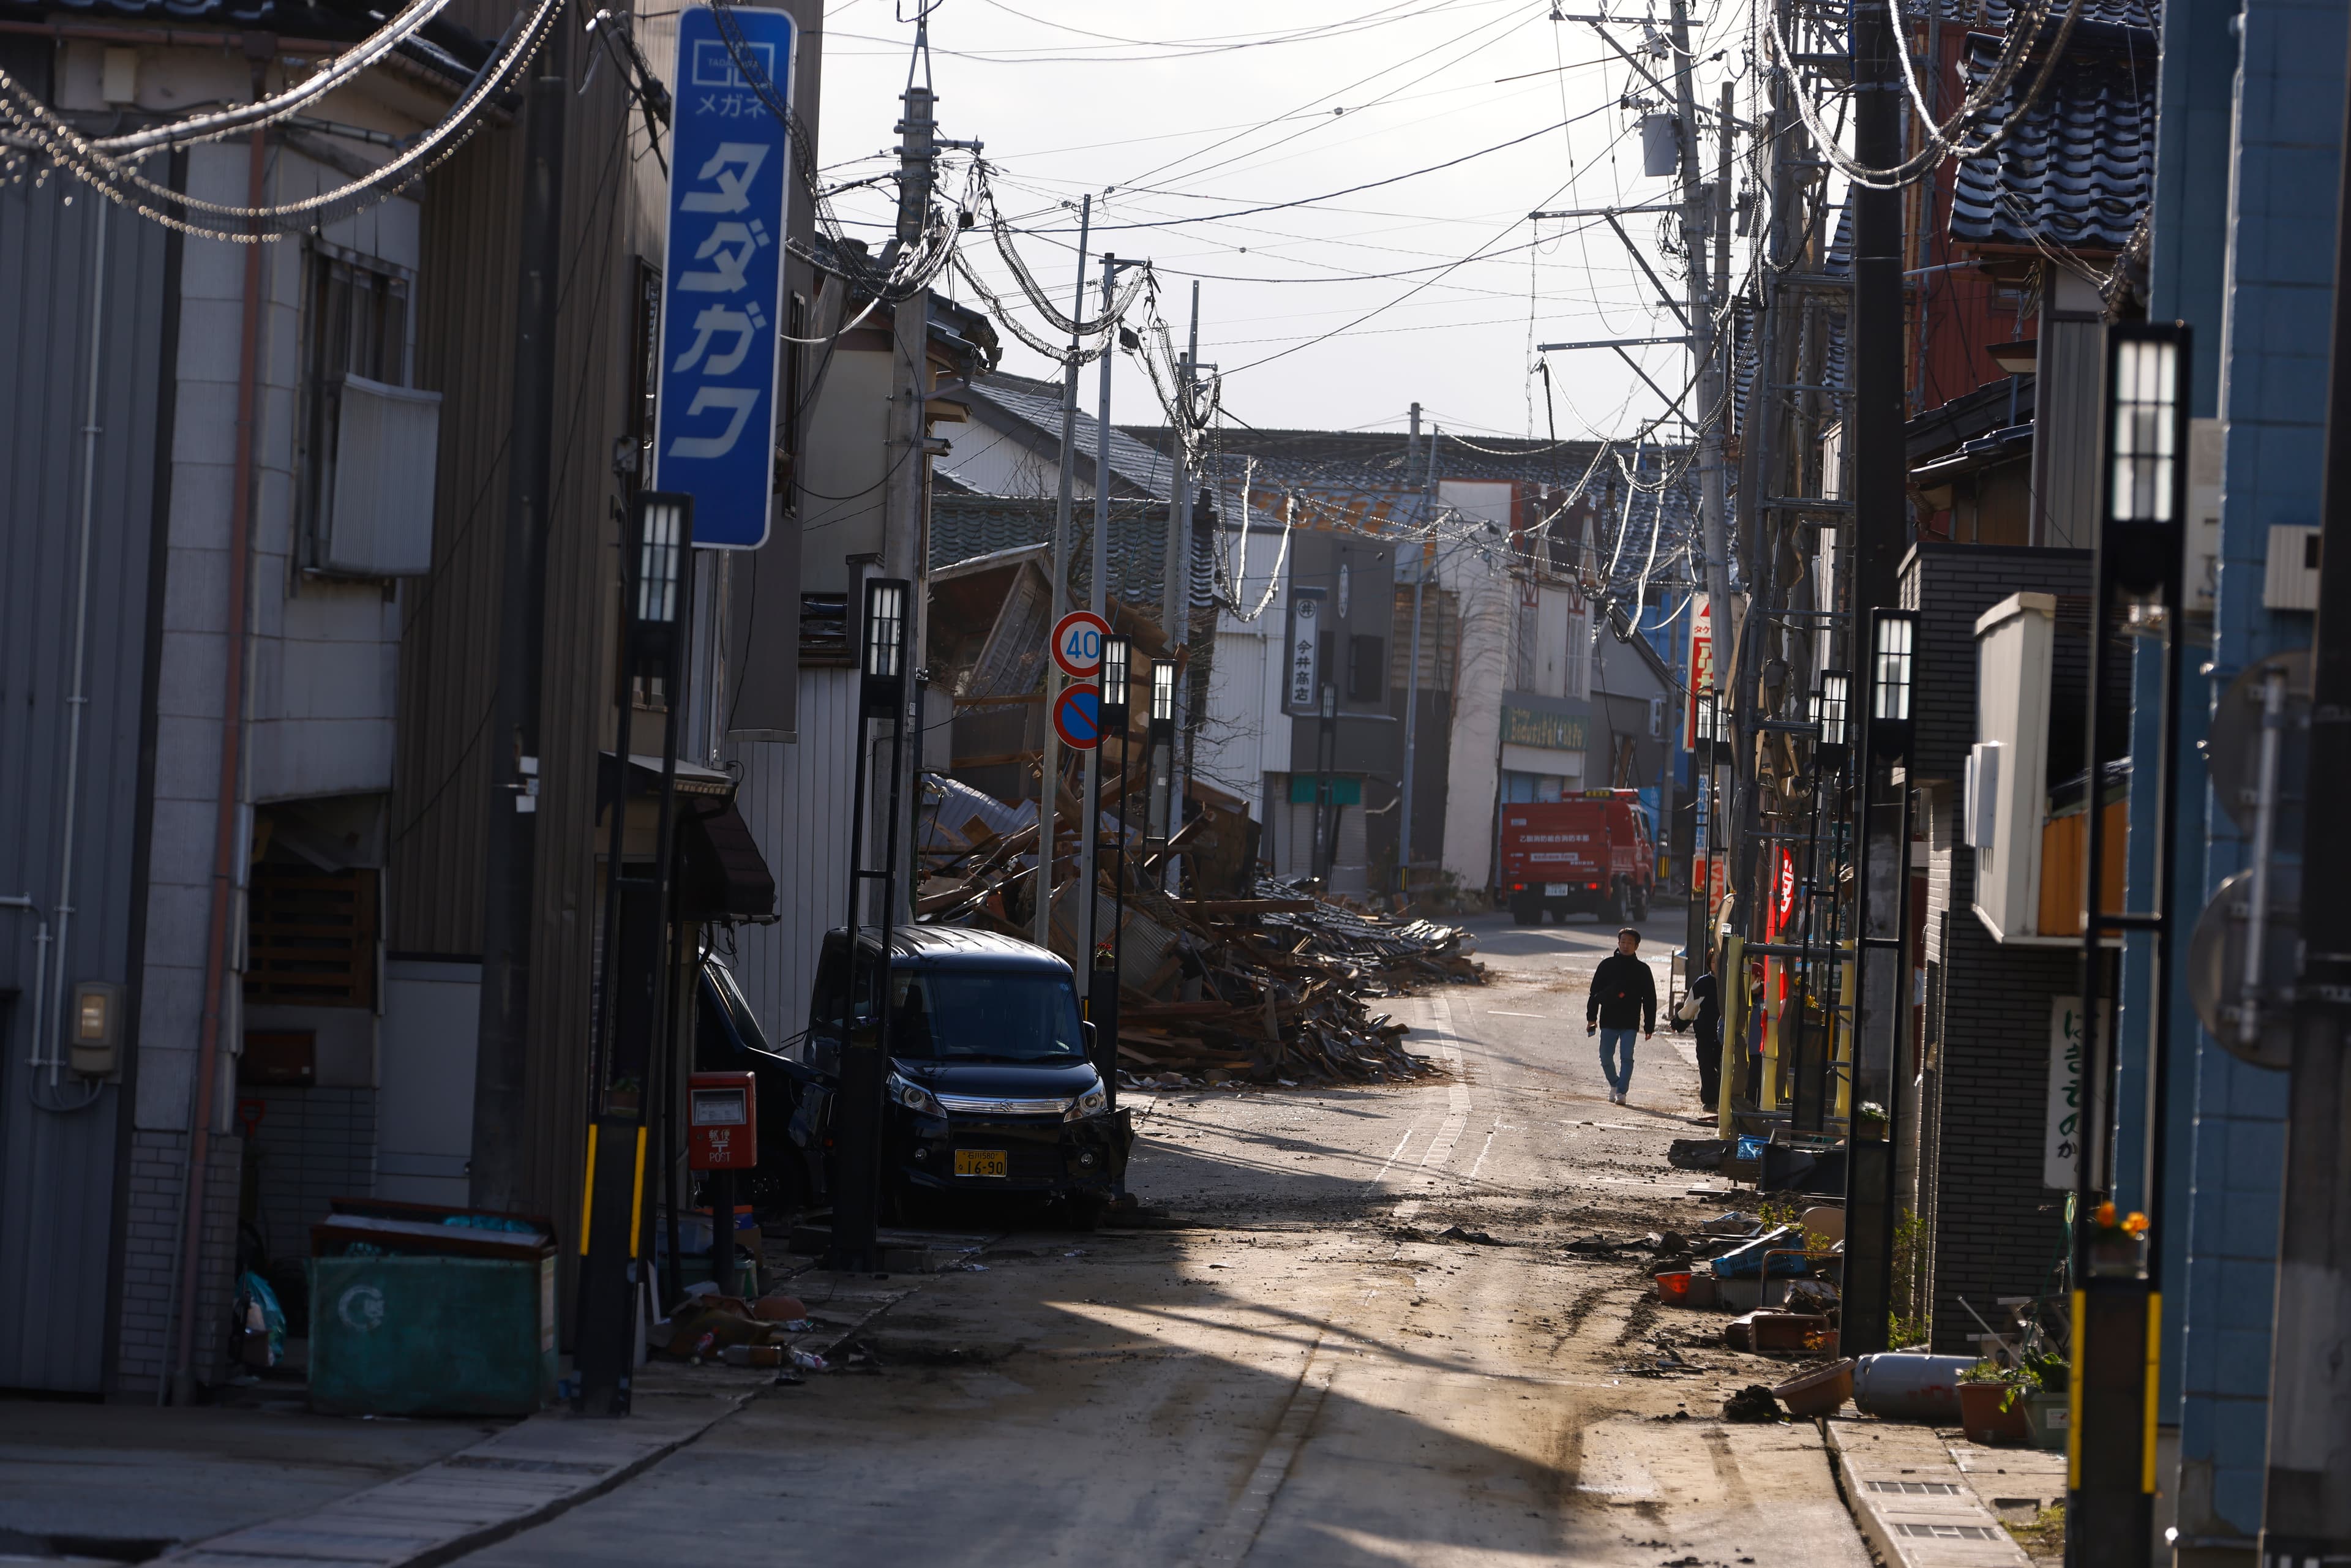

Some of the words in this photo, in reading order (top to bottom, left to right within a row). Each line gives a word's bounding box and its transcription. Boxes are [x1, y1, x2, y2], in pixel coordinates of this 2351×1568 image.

[696, 93, 767, 118] メガネ
[668, 142, 770, 459] タダガワ
[1067, 631, 1100, 659] 40
[1294, 640, 1313, 701] 今井商店
[709, 1130, 730, 1141] 郵便
[710, 1152, 730, 1162] POST
[968, 1161, 1003, 1174] 16-90
